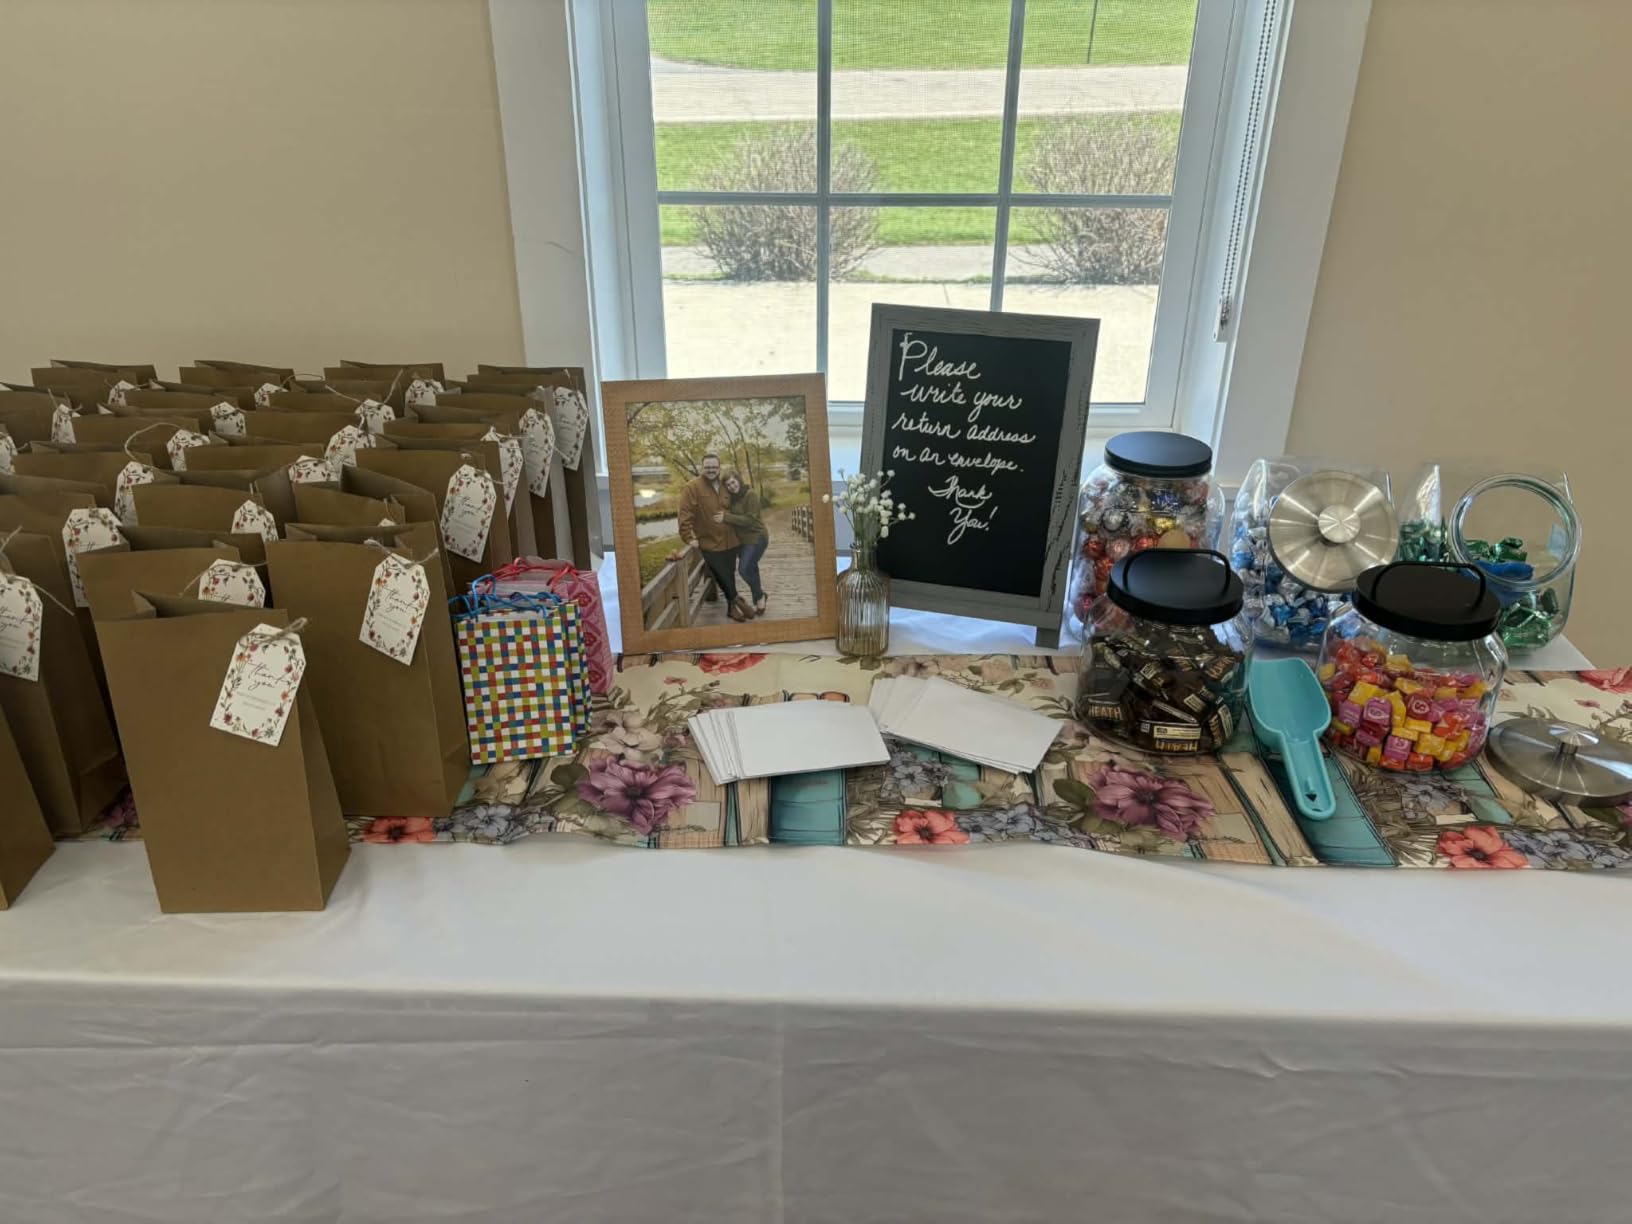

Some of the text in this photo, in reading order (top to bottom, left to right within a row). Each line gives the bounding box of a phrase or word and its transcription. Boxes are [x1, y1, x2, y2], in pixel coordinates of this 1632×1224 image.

[899, 332, 981, 381] Please
[901, 382, 1022, 423] write your
[891, 412, 961, 439] return
[892, 445, 1024, 476] on an envelope.
[927, 475, 993, 509] Thank
[947, 506, 998, 545] You!
[247, 661, 290, 685] thank
[247, 680, 276, 692] you
[1088, 704, 1123, 720] HEATH
